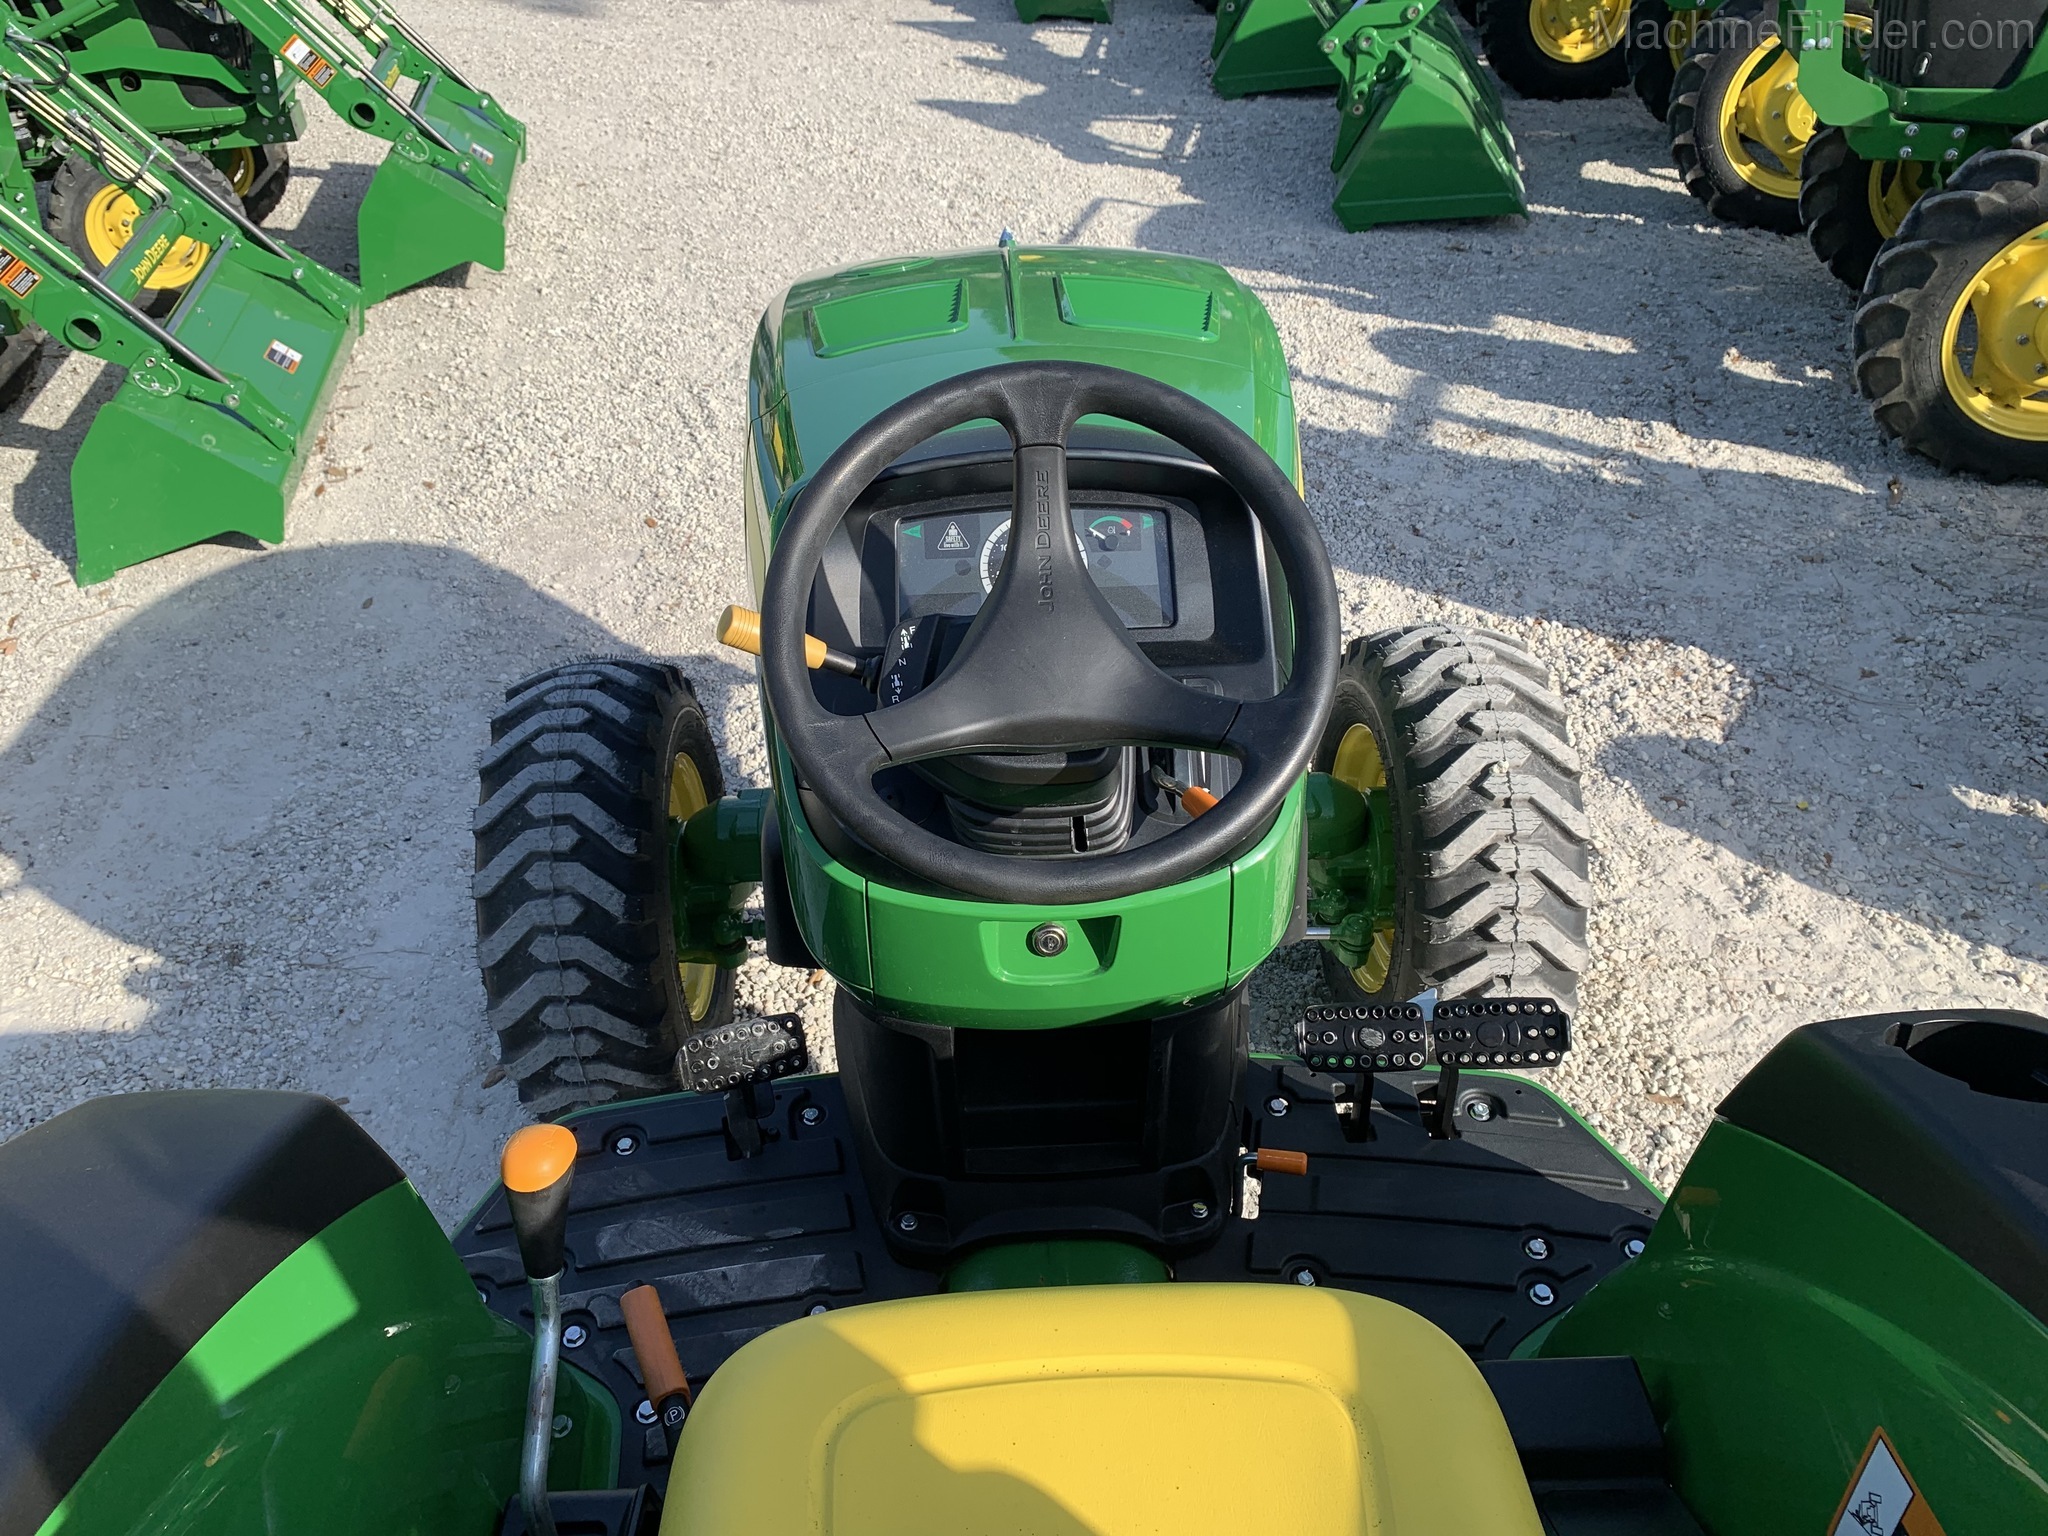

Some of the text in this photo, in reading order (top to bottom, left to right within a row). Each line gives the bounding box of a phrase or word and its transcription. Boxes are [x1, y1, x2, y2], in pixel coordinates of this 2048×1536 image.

[130, 233, 170, 285] JOHN DEERE
[1035, 470, 1055, 615] JOHN DEERE
[909, 625, 916, 635] F
[898, 658, 907, 667] N
[891, 695, 900, 704] R
[670, 1410, 678, 1421] P
